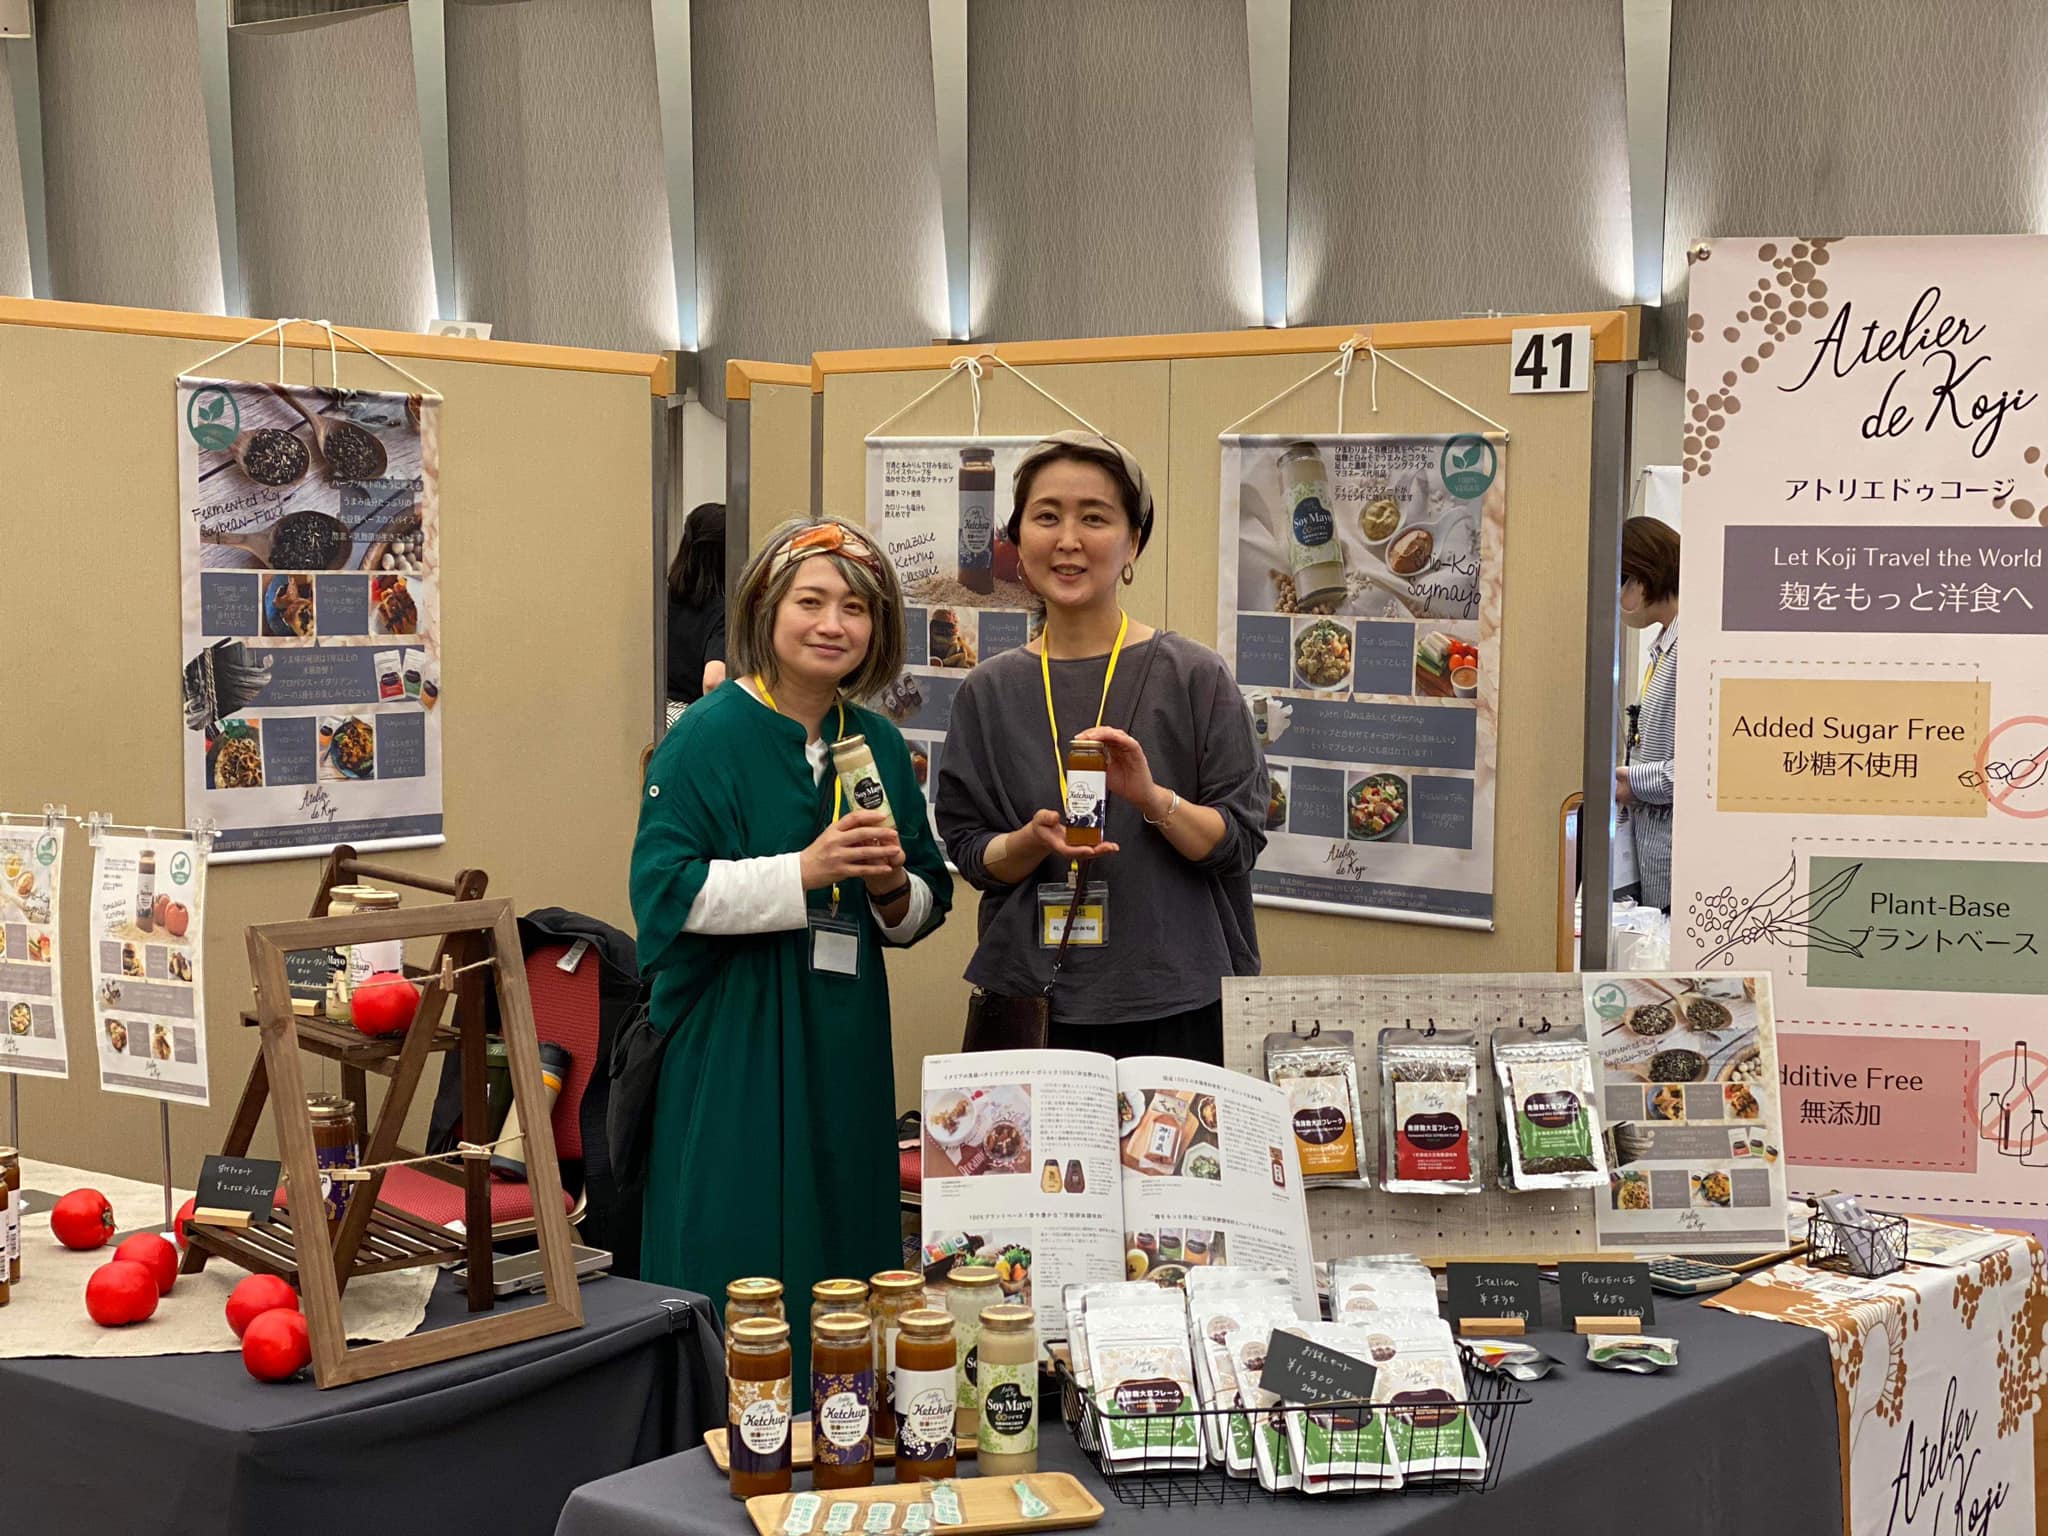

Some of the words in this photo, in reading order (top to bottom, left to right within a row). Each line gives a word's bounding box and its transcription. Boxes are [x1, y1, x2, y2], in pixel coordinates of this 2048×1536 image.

[1777, 286, 1987, 392] Atelier
[1514, 332, 1573, 389] 41
[1861, 370, 1914, 439] de
[1922, 350, 2038, 458] Koji
[1785, 478, 2016, 502] アトリエドゥコージ
[895, 550, 934, 568] Ketchup
[1774, 547, 1809, 567] Let
[1816, 547, 1857, 570] Koji
[1864, 547, 1931, 568] Travel
[1937, 548, 1971, 568] the
[1978, 549, 2042, 569] World
[1778, 581, 2034, 613] 麹をもっと洋食へ
[1732, 716, 1814, 740] Added
[1823, 717, 1899, 744] Sugar
[1908, 718, 1965, 741] Free
[1782, 752, 1919, 778] 砂糖不使用
[1870, 892, 2010, 919] Plant-Base
[1848, 926, 2039, 955] プラントベース
[1779, 1065, 1857, 1089] dditive
[1867, 1067, 1923, 1091] Free
[1800, 1098, 1881, 1126] 無添加
[1475, 1275, 1520, 1288] Italian
[1581, 1271, 1636, 1286] PROVENCE
[824, 1407, 866, 1419] Ketchup
[912, 1403, 953, 1416] Ketchup
[987, 1399, 1004, 1414] Soy
[1005, 1399, 1032, 1413] Mayo
[744, 1414, 786, 1427] Ketchup
[1887, 1376, 1978, 1536] Atelier
